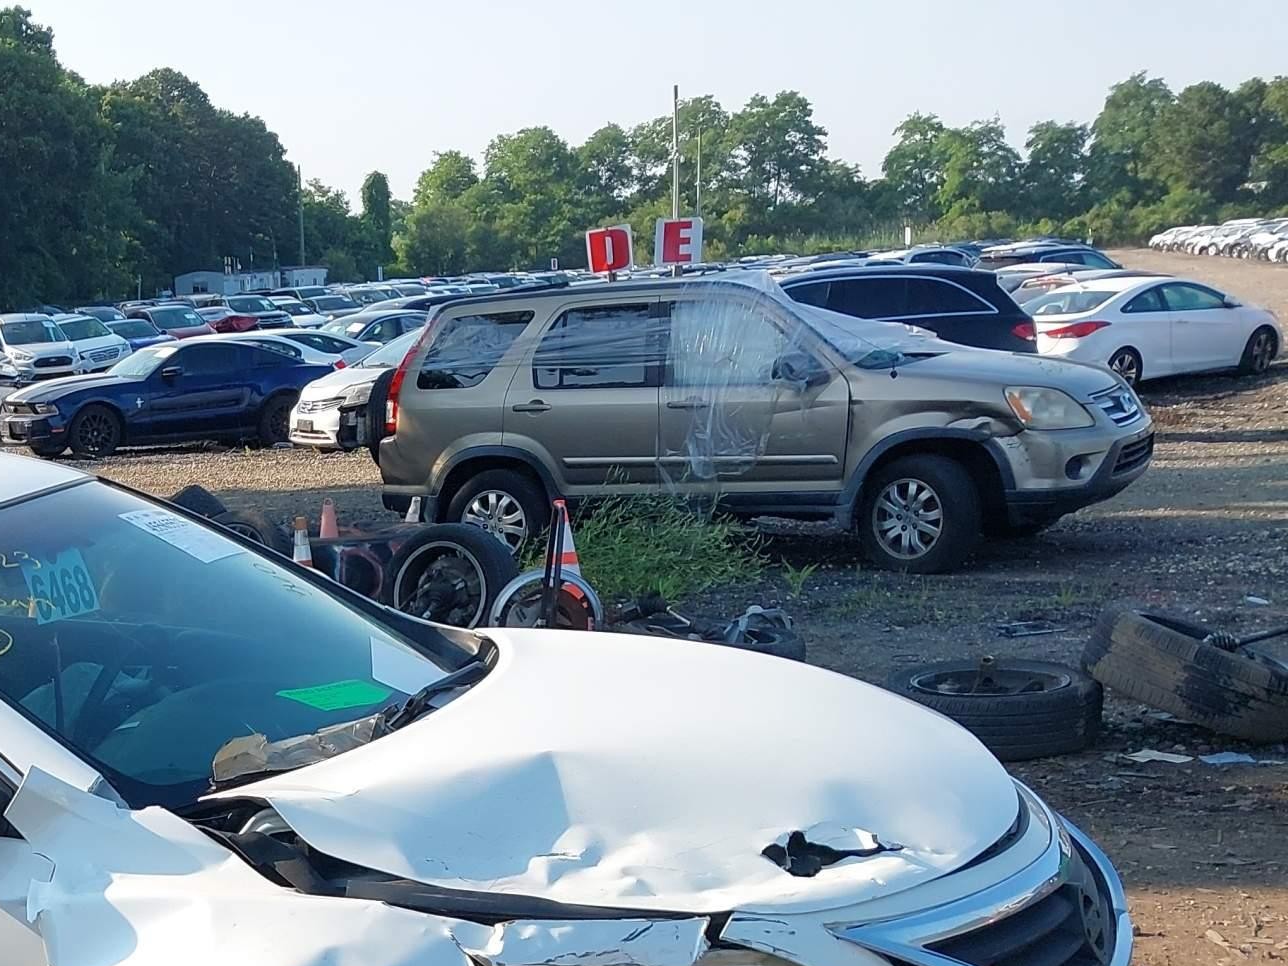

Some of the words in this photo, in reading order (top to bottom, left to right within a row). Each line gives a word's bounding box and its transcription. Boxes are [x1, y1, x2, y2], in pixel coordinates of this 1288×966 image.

[589, 228, 630, 273] D
[662, 220, 693, 263] E
[31, 564, 96, 622] 6468
